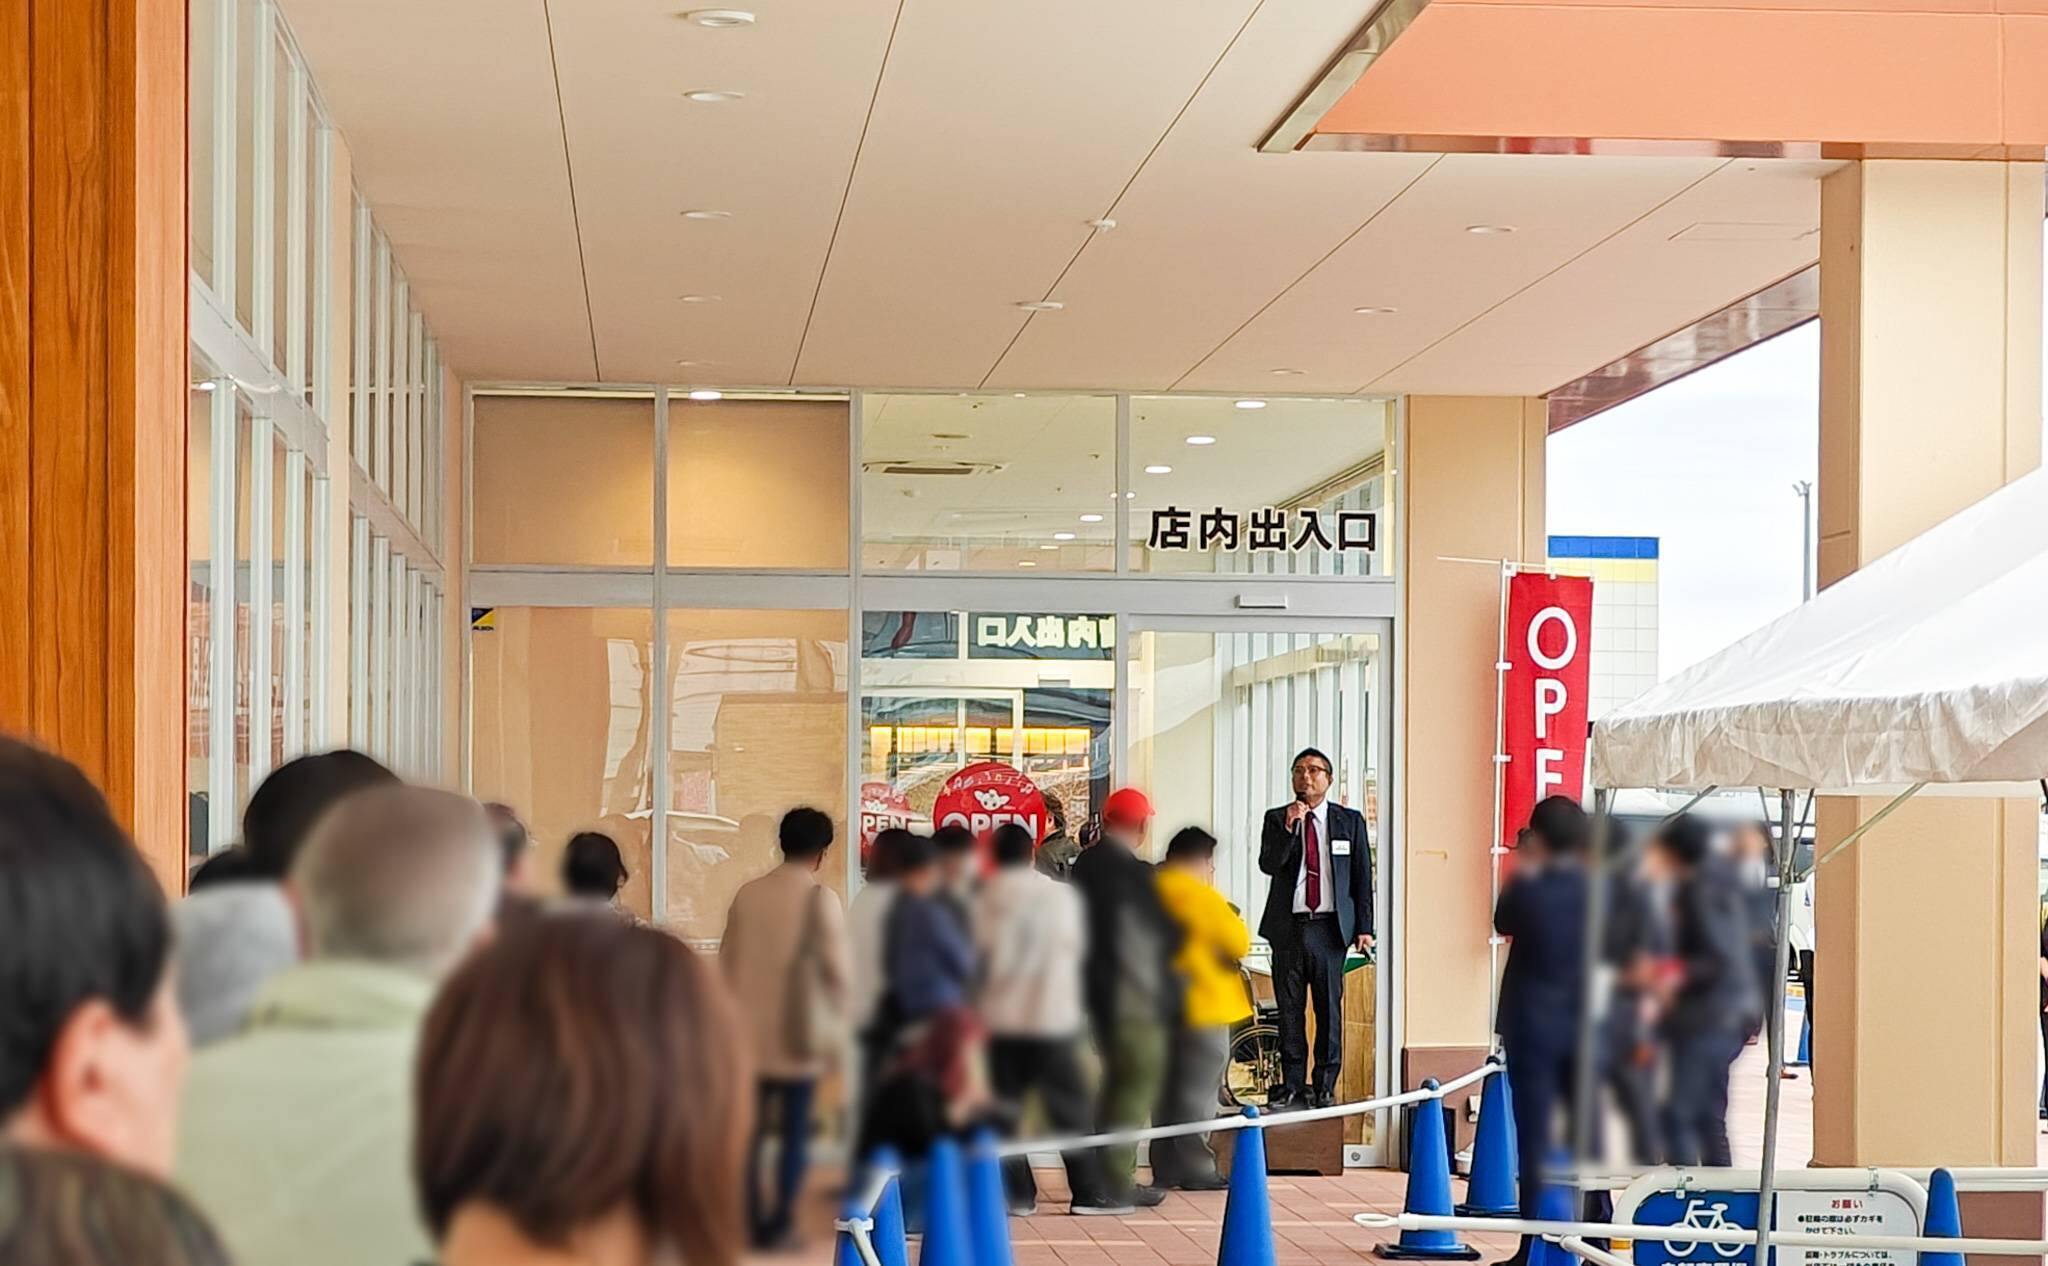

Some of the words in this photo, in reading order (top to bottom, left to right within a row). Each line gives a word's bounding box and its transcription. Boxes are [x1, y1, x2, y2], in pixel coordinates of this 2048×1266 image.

[1149, 506, 1377, 552] 店内出入口
[1527, 605, 1578, 804] OPE
[862, 815, 905, 832] PEN
